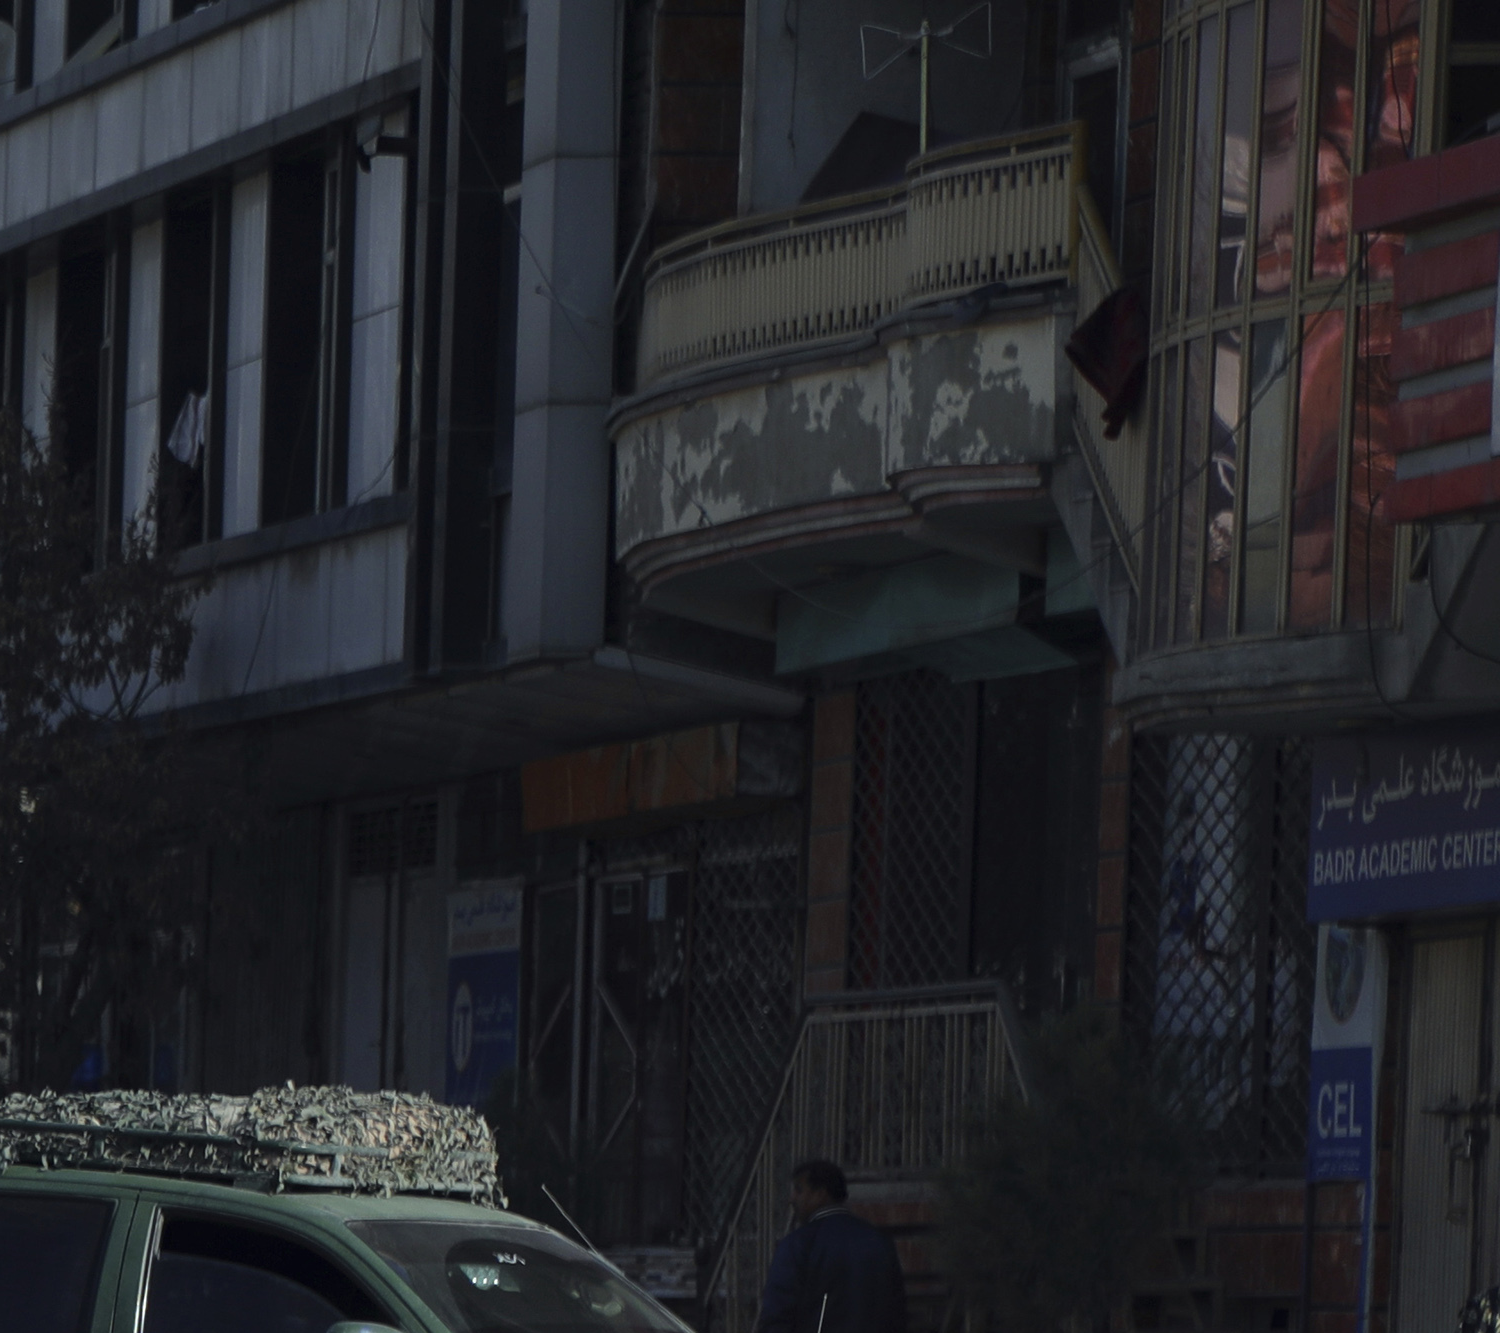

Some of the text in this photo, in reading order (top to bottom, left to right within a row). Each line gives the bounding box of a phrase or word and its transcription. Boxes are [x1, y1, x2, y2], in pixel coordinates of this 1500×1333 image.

[1317, 778, 1357, 830] بدر
[1362, 752, 1416, 824] علمی
[1314, 847, 1355, 887] BADR
[1358, 833, 1438, 881] ACADEMIC
[1317, 1082, 1362, 1139] CEL
